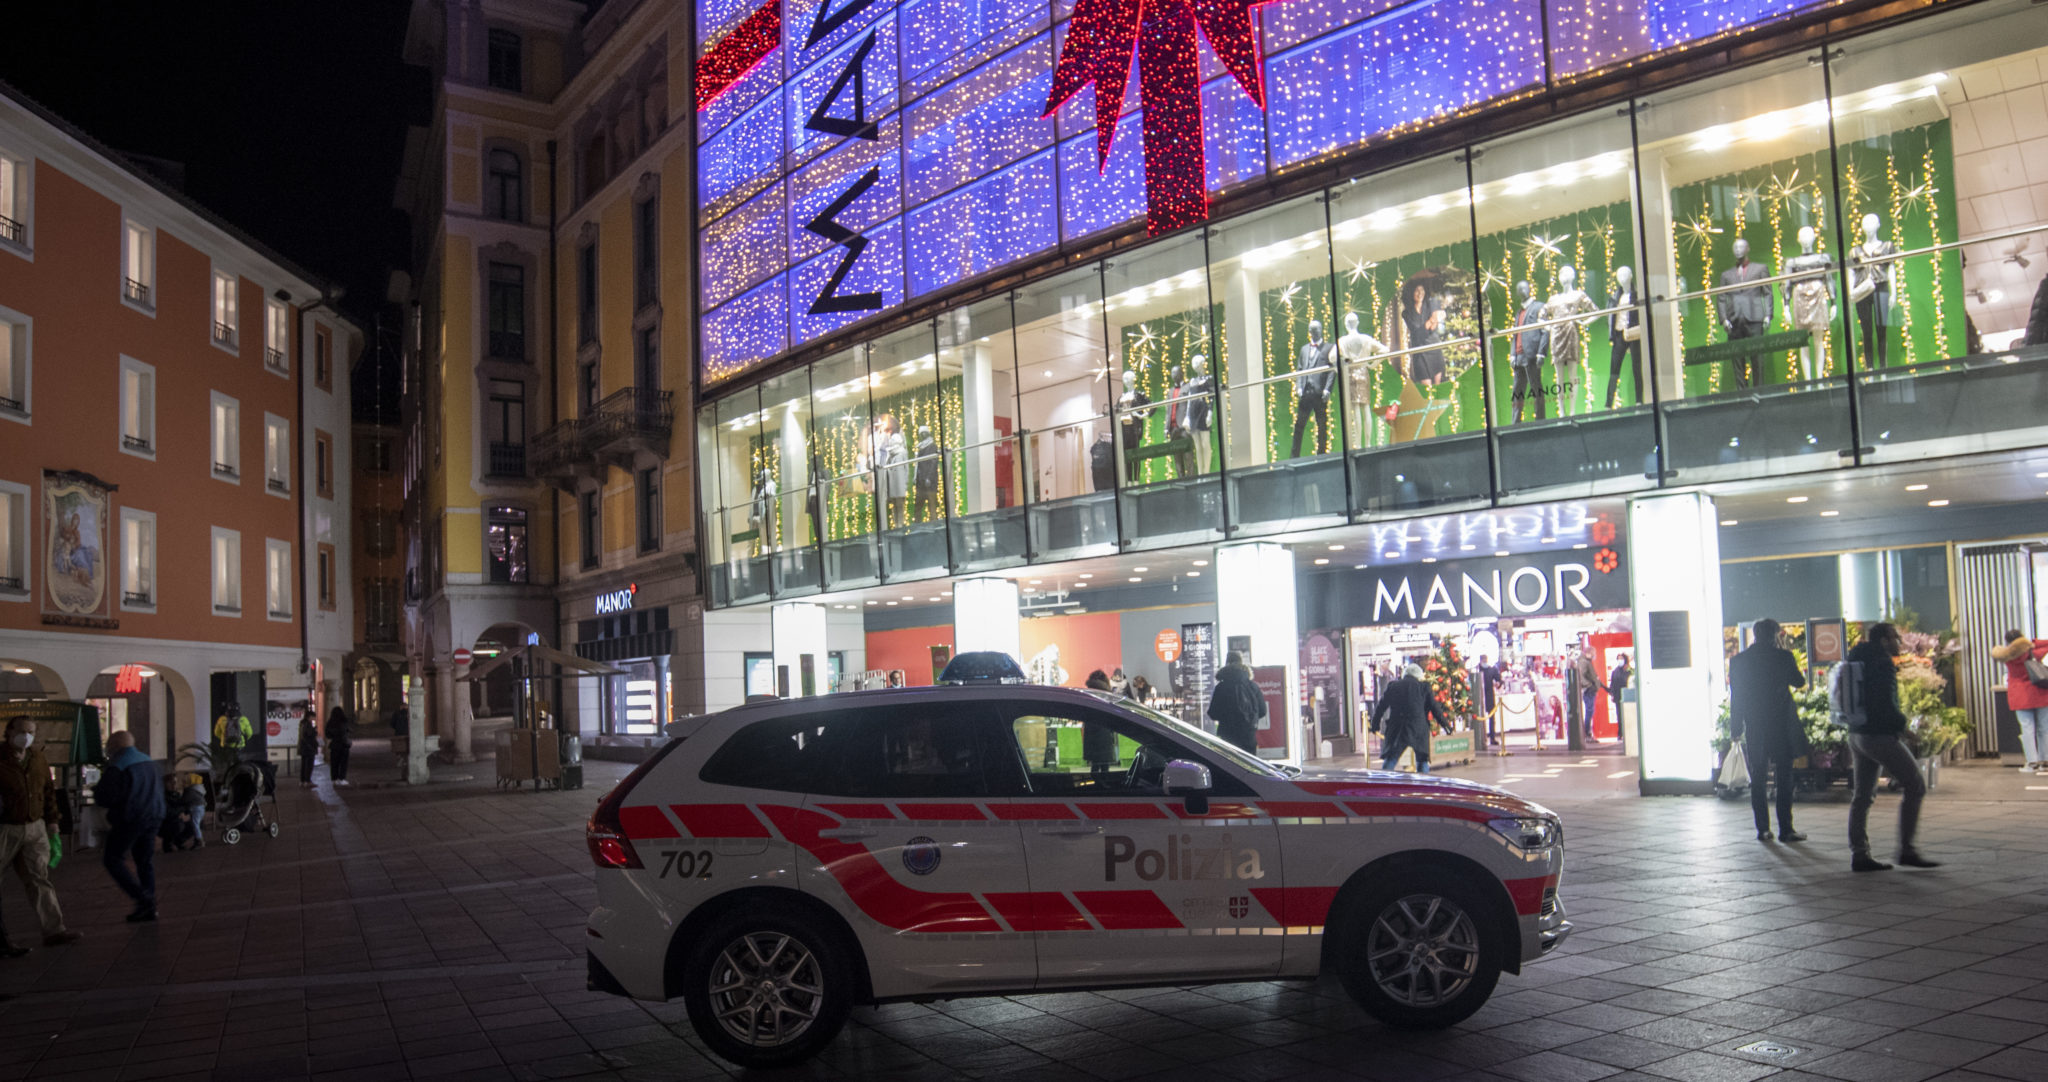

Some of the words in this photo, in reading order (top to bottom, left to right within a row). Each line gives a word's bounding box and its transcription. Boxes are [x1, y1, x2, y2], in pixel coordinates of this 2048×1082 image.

[1511, 382, 1573, 402] MANOR
[596, 589, 632, 615] MANOR
[1372, 562, 1592, 622] MANOR
[1188, 643, 1211, 651] GIORNI
[267, 711, 304, 721] wopar
[659, 850, 713, 879] 702
[1104, 833, 1265, 881] Polizia
